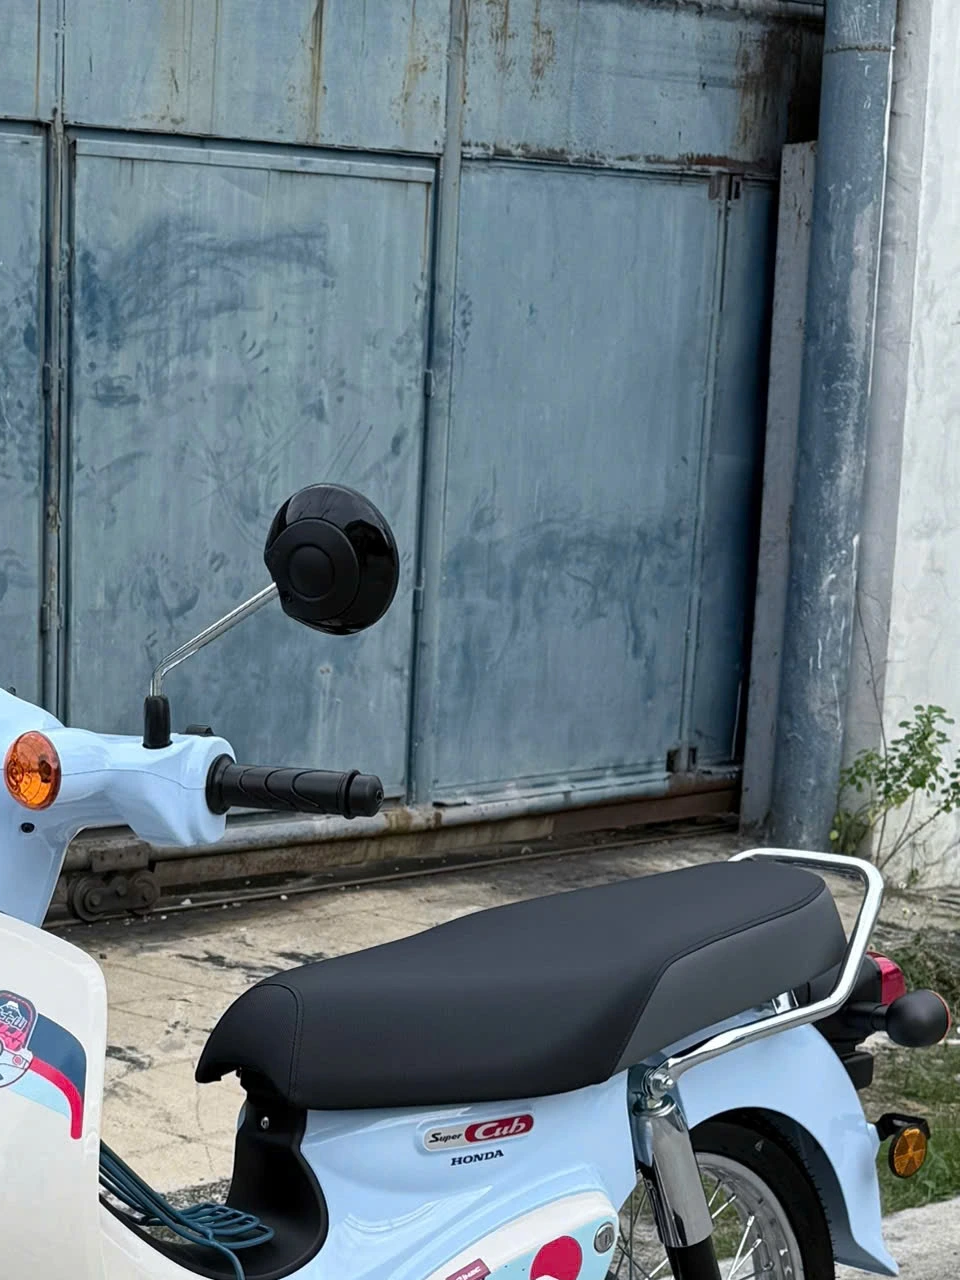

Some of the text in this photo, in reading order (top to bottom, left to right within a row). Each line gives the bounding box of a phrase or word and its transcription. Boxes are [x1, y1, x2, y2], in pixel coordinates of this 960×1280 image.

[428, 1117, 526, 1143] Super Cub
[450, 1149, 504, 1166] HONDA
